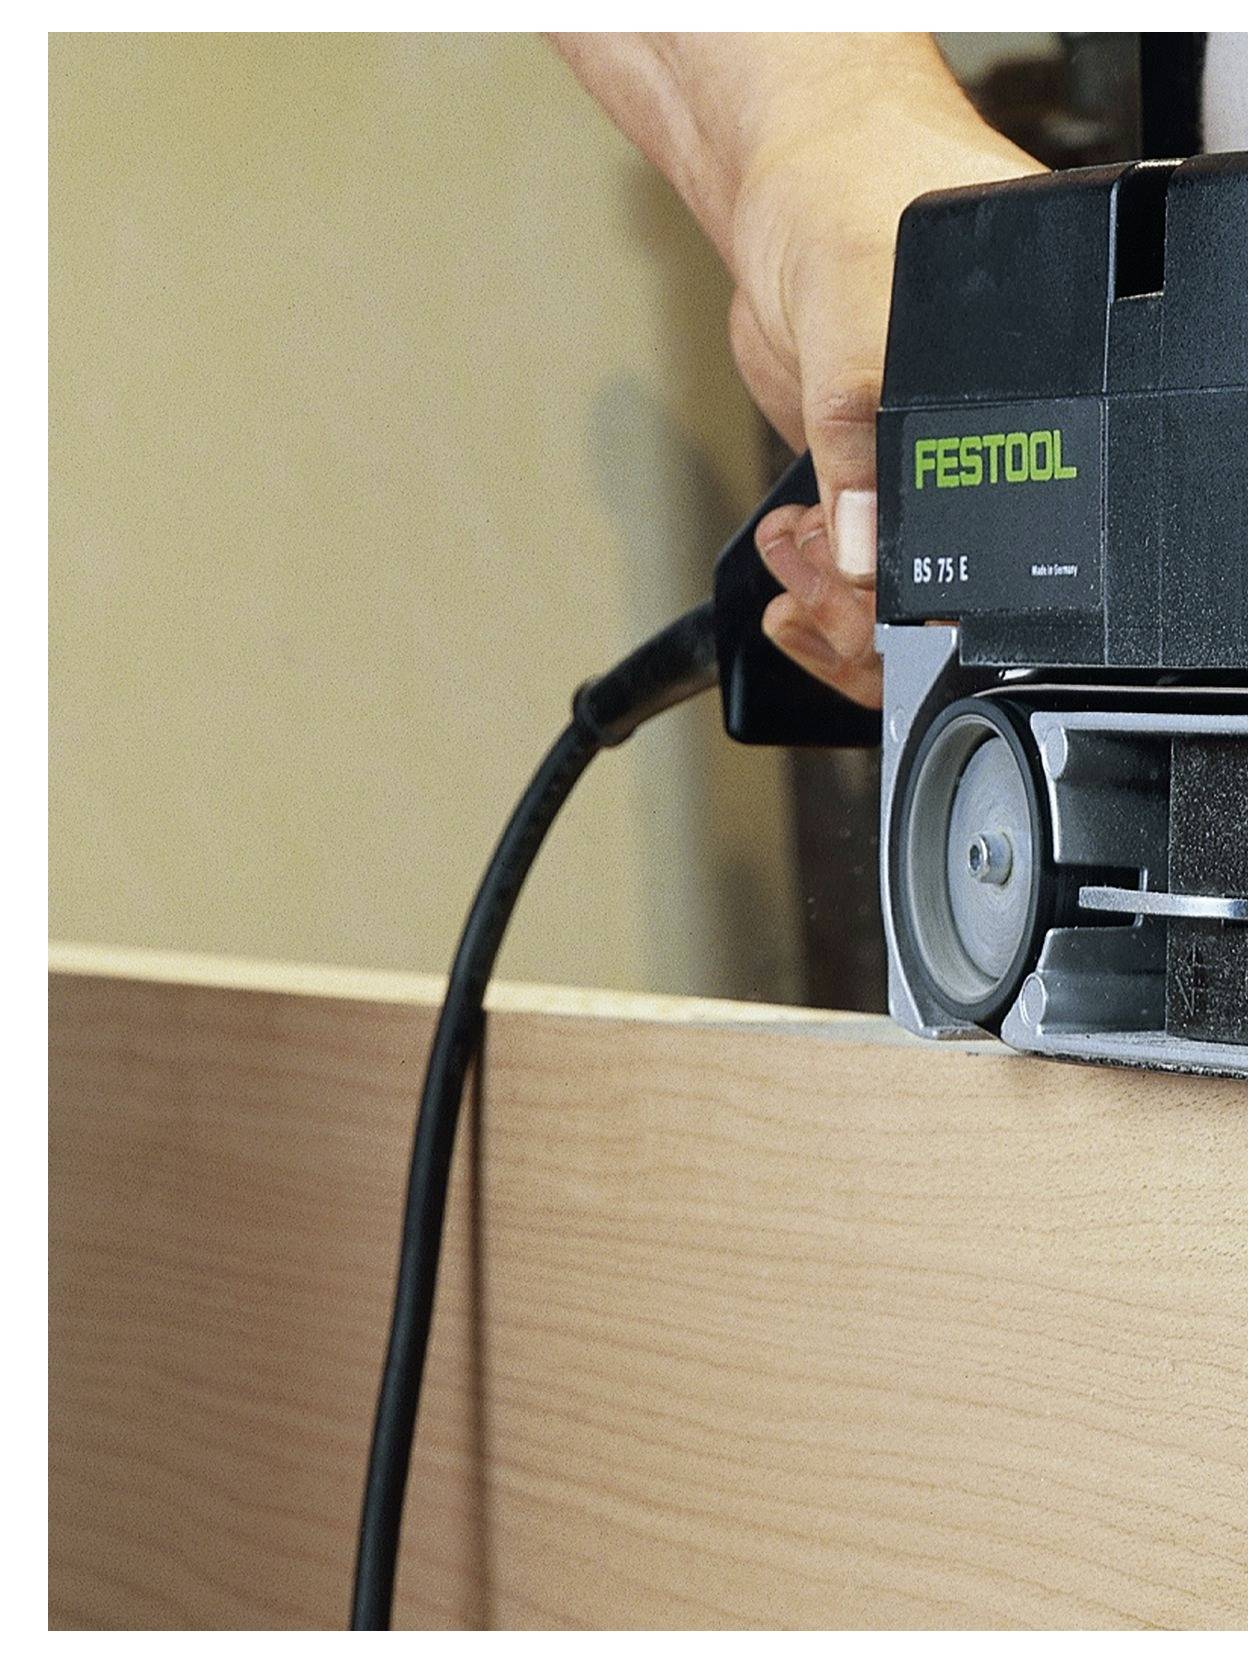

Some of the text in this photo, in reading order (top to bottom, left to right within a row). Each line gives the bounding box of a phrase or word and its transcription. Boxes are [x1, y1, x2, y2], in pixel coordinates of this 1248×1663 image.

[914, 429, 1078, 490] FESTOOL
[913, 556, 969, 583] BS 75 E
